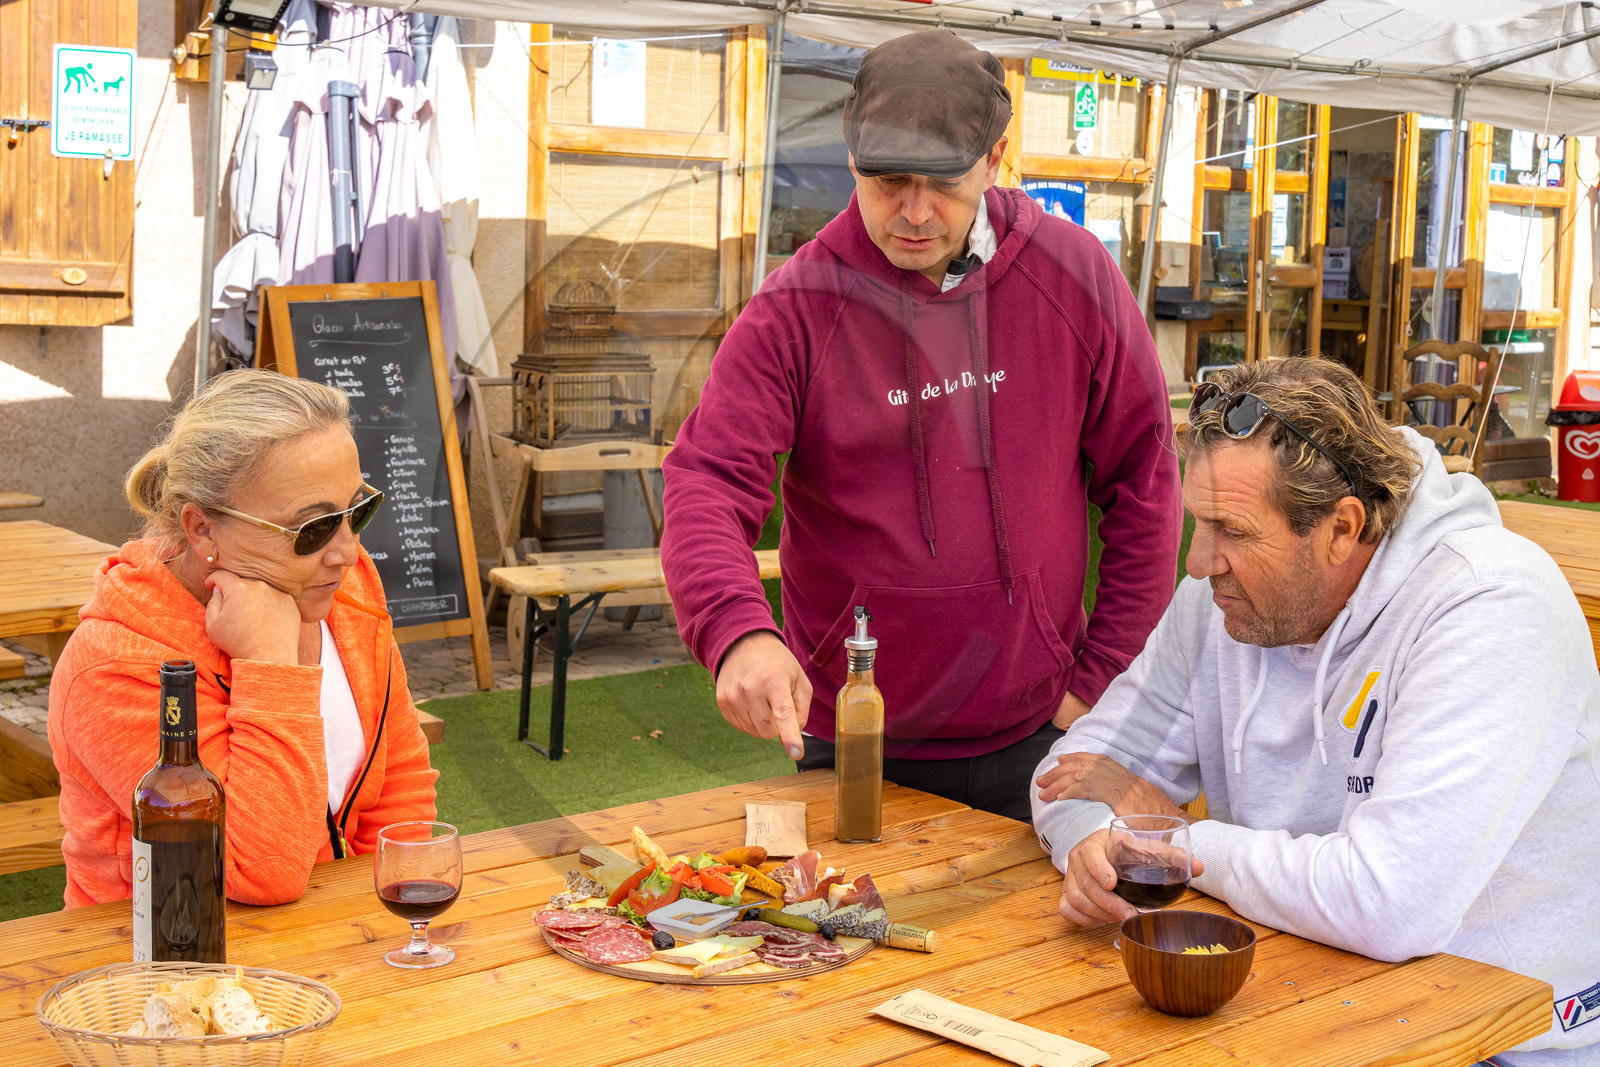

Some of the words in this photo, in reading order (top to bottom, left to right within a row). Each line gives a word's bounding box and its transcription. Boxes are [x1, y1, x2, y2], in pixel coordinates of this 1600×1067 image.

[65, 131, 75, 141] JE
[79, 131, 122, 144] RAMASSE
[1048, 181, 1067, 190] HAUTES
[1067, 183, 1083, 194] ALPES
[312, 314, 344, 334] Glaces
[336, 378, 363, 387] boules
[887, 389, 910, 406] Git
[921, 382, 941, 400] de
[944, 378, 958, 395] la
[390, 457, 427, 467] Framboise
[392, 469, 418, 477] Citron
[392, 480, 416, 492] Figue
[395, 490, 420, 500] Fraise
[409, 550, 436, 562] Marron
[410, 563, 433, 575] Melon
[412, 577, 434, 588] Poire
